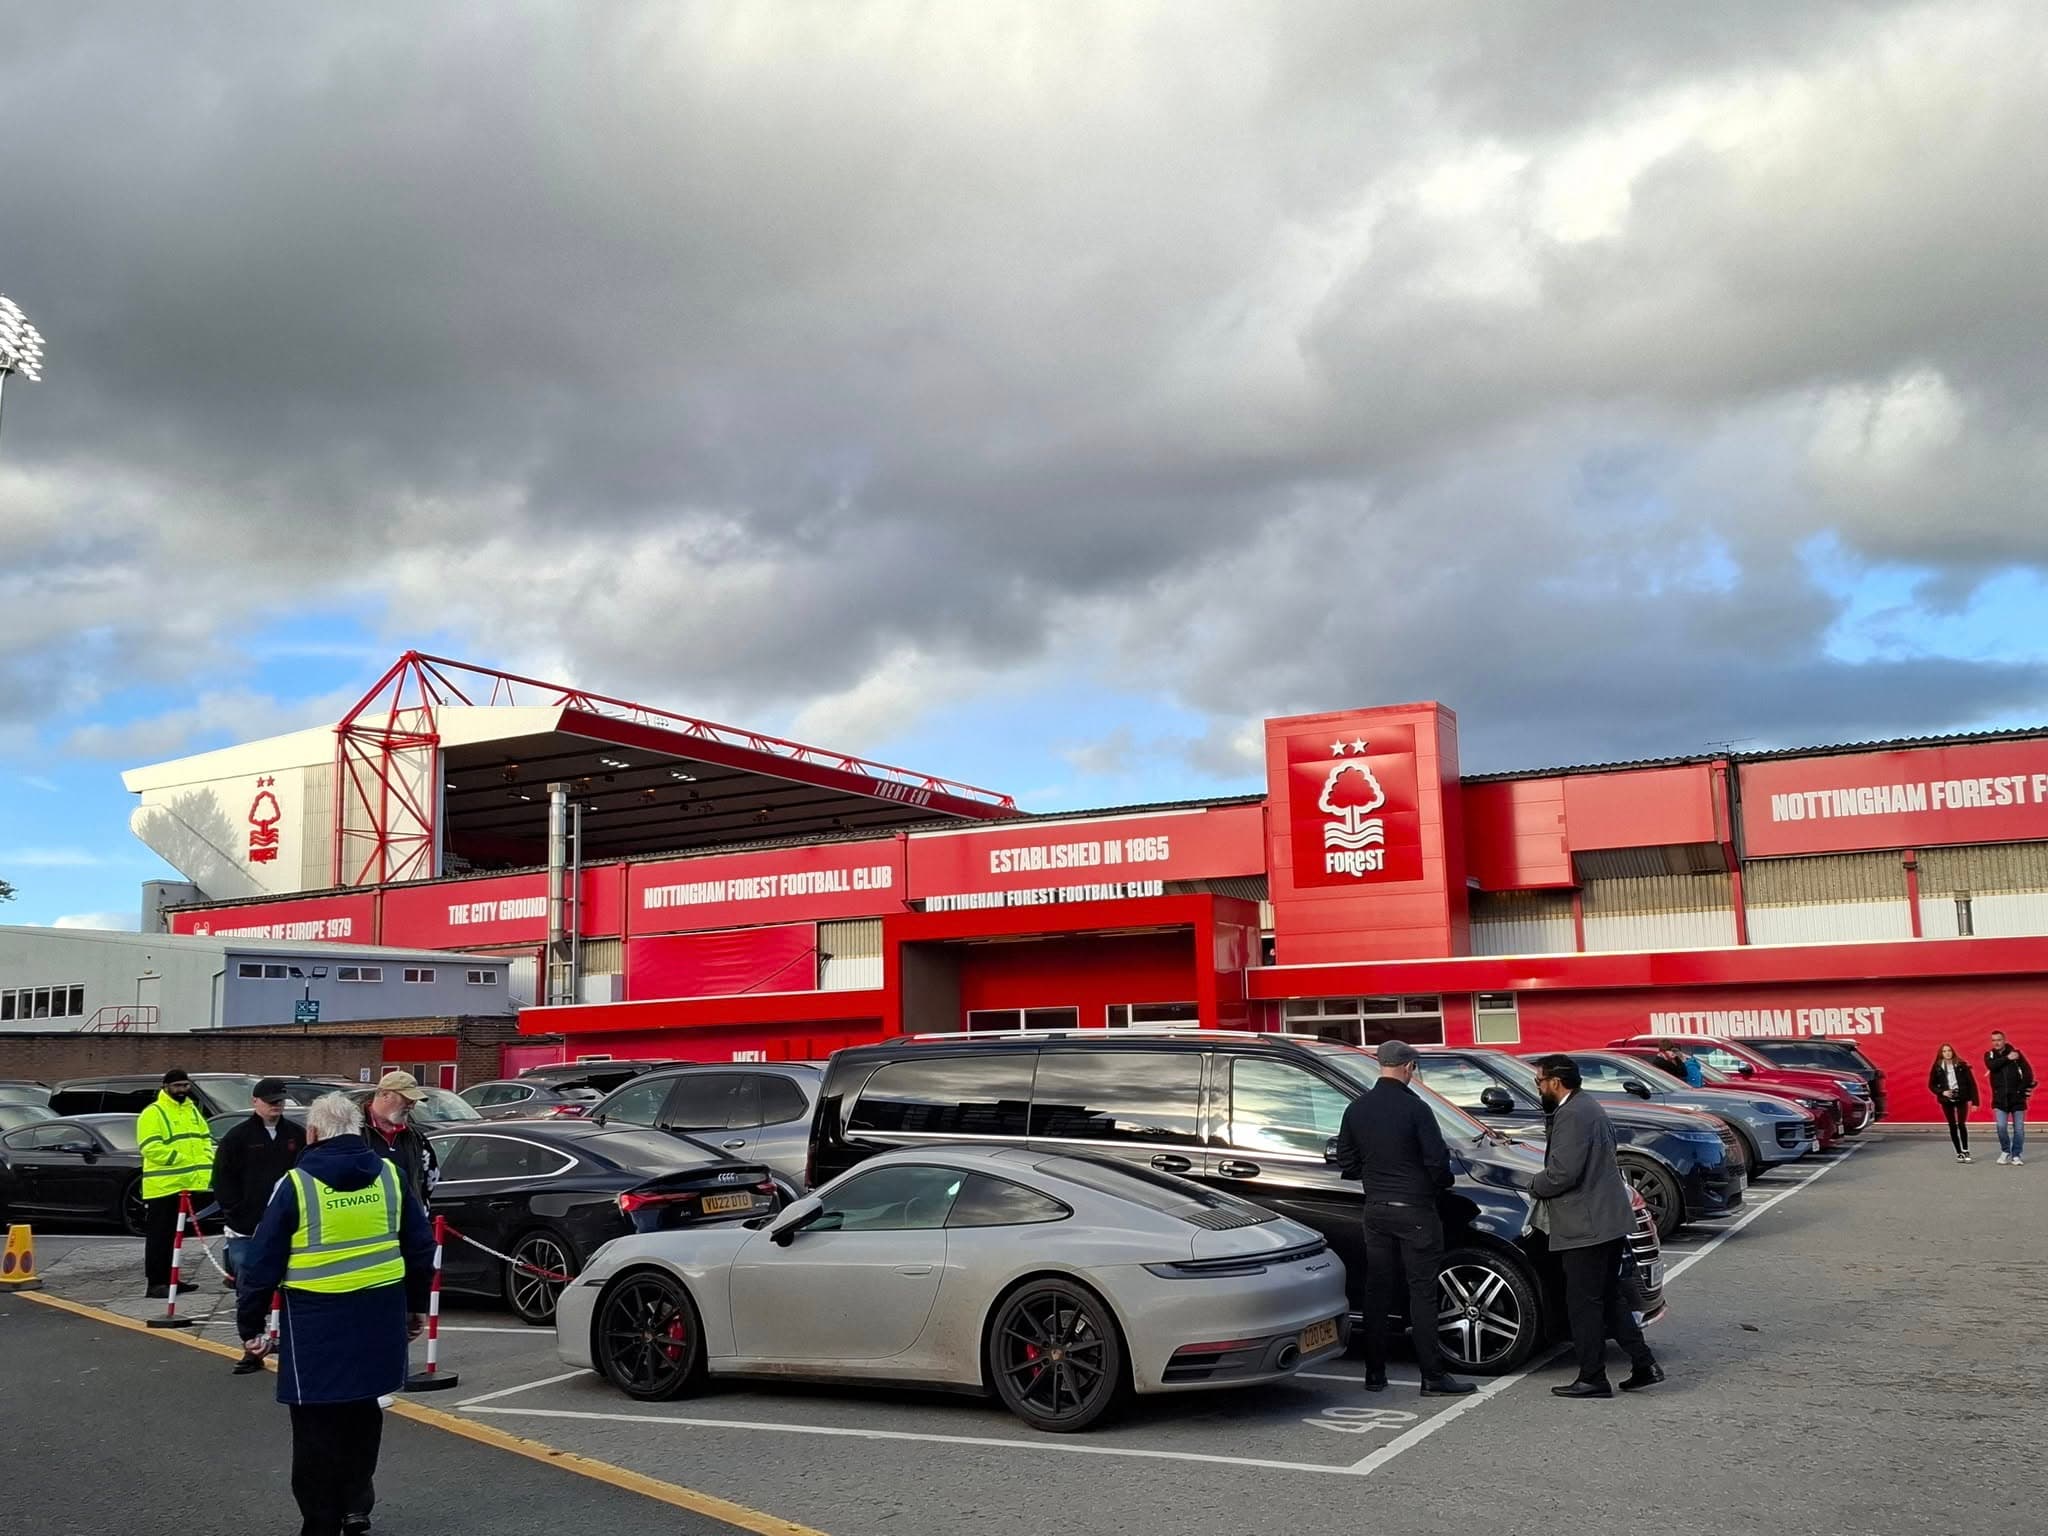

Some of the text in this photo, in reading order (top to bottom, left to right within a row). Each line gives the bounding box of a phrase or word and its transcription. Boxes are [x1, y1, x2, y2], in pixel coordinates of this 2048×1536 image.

[874, 780, 932, 806] TRENT END
[1771, 774, 2048, 822] NOTTINGHAM FOREST F
[990, 836, 1169, 873] ESTABLISHED IN 1865
[644, 866, 892, 909] NOTTINGHAM FOREST FOOTBALL CLUB
[925, 880, 1163, 912] NOTTINGHAM FOREST FOOTBALL CLUB
[448, 896, 547, 925] THE CITY GROUND
[286, 920, 325, 940] EUROPE
[327, 917, 352, 937] 1979
[1650, 1007, 1884, 1037] NOTTINGHAM FOREST
[326, 1193, 380, 1210] STEWARD
